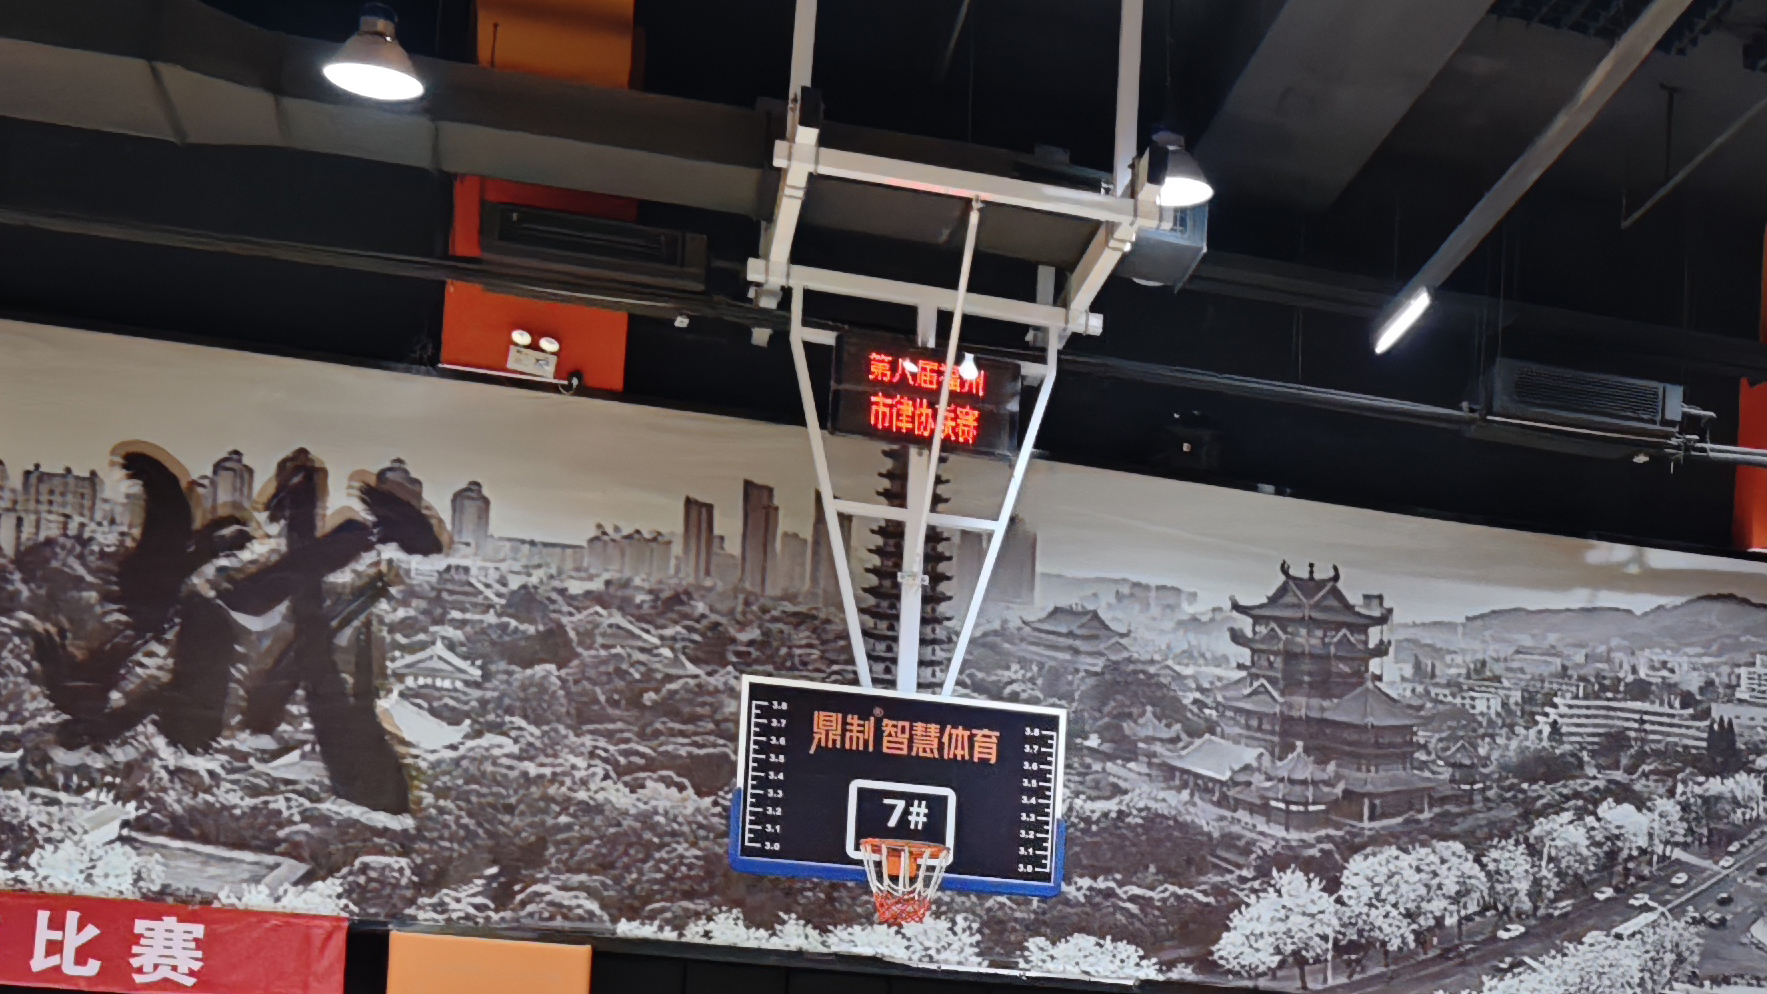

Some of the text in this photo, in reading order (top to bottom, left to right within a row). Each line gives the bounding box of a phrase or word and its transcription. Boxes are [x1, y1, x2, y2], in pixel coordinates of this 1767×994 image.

[772, 701, 788, 710] 3.8
[770, 718, 786, 728] 3.7
[1024, 726, 1040, 736] 3.8
[770, 736, 786, 746] 3.6
[1024, 745, 1038, 754] 3.7
[768, 754, 785, 763] 3.5
[1023, 762, 1038, 770] 3.6
[768, 772, 784, 780] 3.4
[1022, 778, 1037, 788] 3.5
[767, 789, 783, 798] 3.3
[1022, 796, 1036, 804] 3.4
[766, 806, 782, 816] 3.2
[882, 798, 929, 830] 7#
[1020, 813, 1035, 822] 3.3
[764, 824, 780, 833] 3.1
[1020, 830, 1034, 839] 3.2
[764, 841, 780, 850] 3.0
[1018, 847, 1033, 856] 3.1
[1018, 864, 1032, 873] 3.0
[29, 909, 205, 987] 比赛
